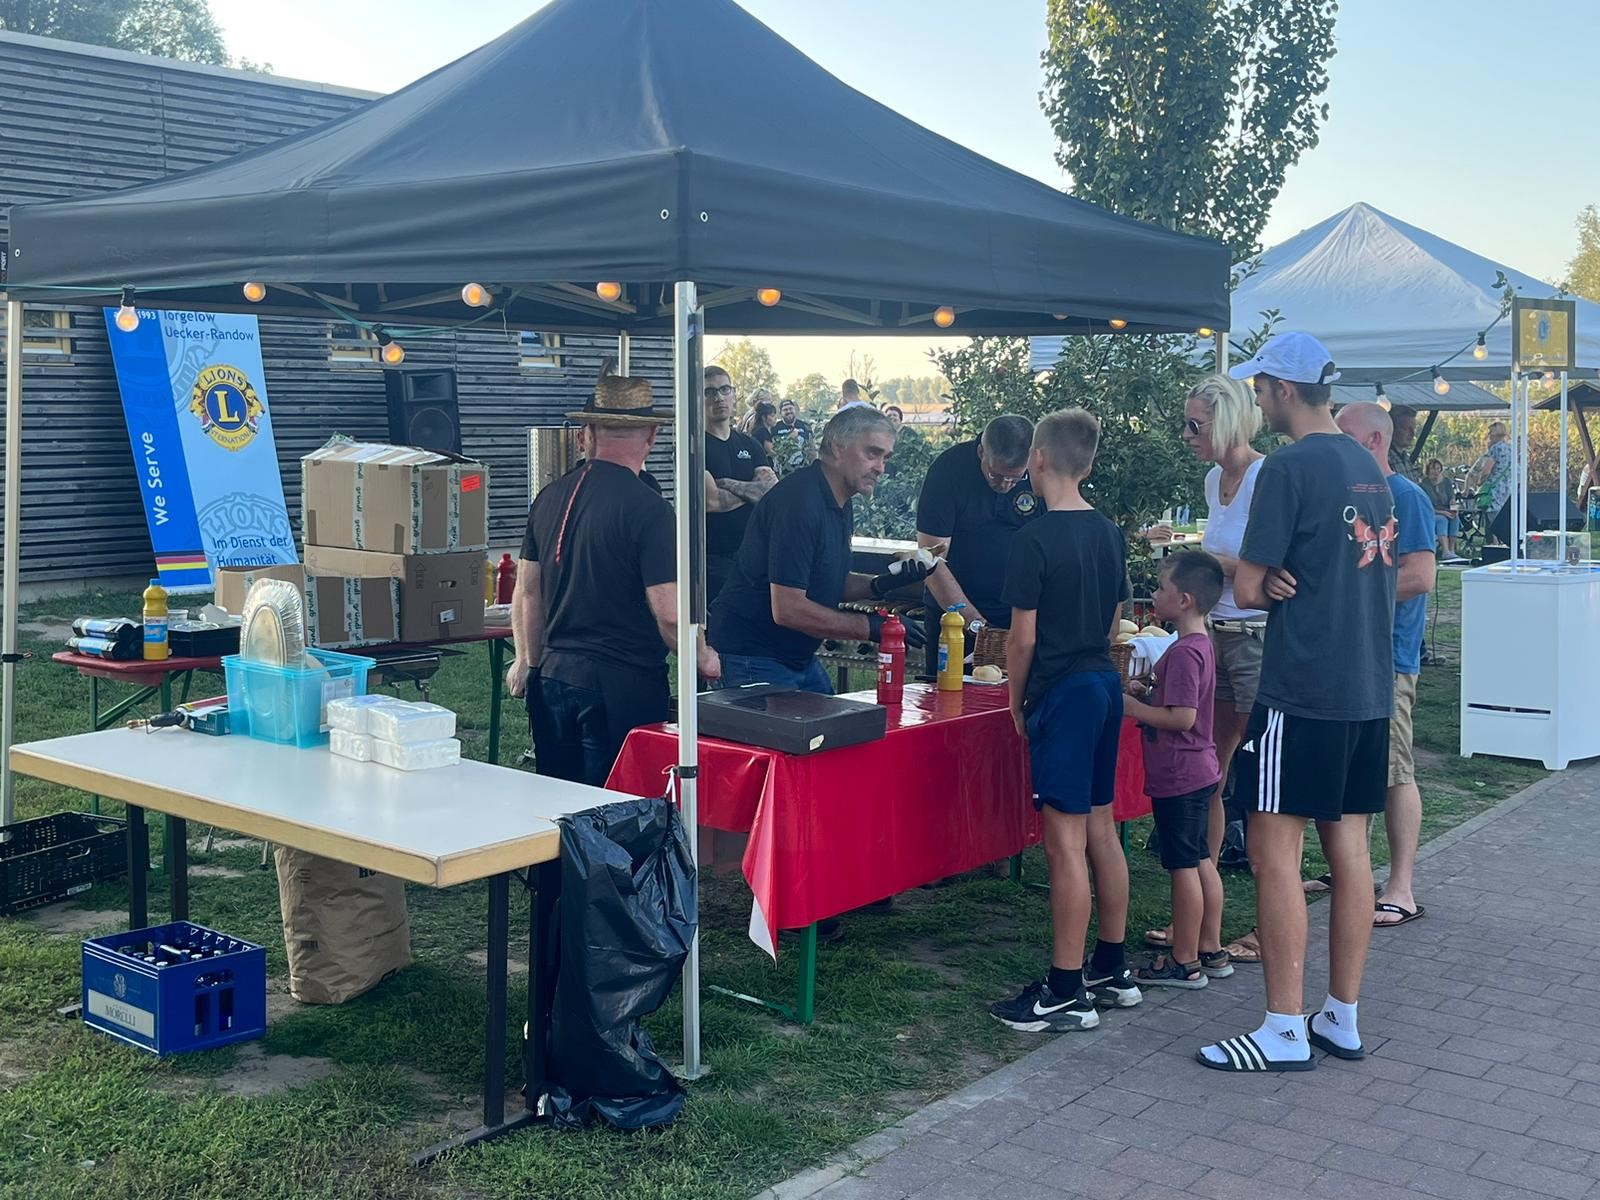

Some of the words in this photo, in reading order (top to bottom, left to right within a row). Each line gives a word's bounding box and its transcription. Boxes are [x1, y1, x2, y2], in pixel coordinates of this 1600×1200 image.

[137, 310, 157, 320] 1993
[165, 327, 254, 341] Uecker-Randow
[205, 368, 245, 387] LIONS
[214, 390, 240, 423] L
[141, 431, 163, 489] Serve
[152, 495, 169, 526] We
[202, 501, 289, 540] LIONS
[212, 537, 228, 549] Im
[231, 535, 267, 549] Dienst
[269, 535, 289, 548] der
[216, 552, 278, 567] Humanität
[105, 1004, 136, 1027] MORELLI
